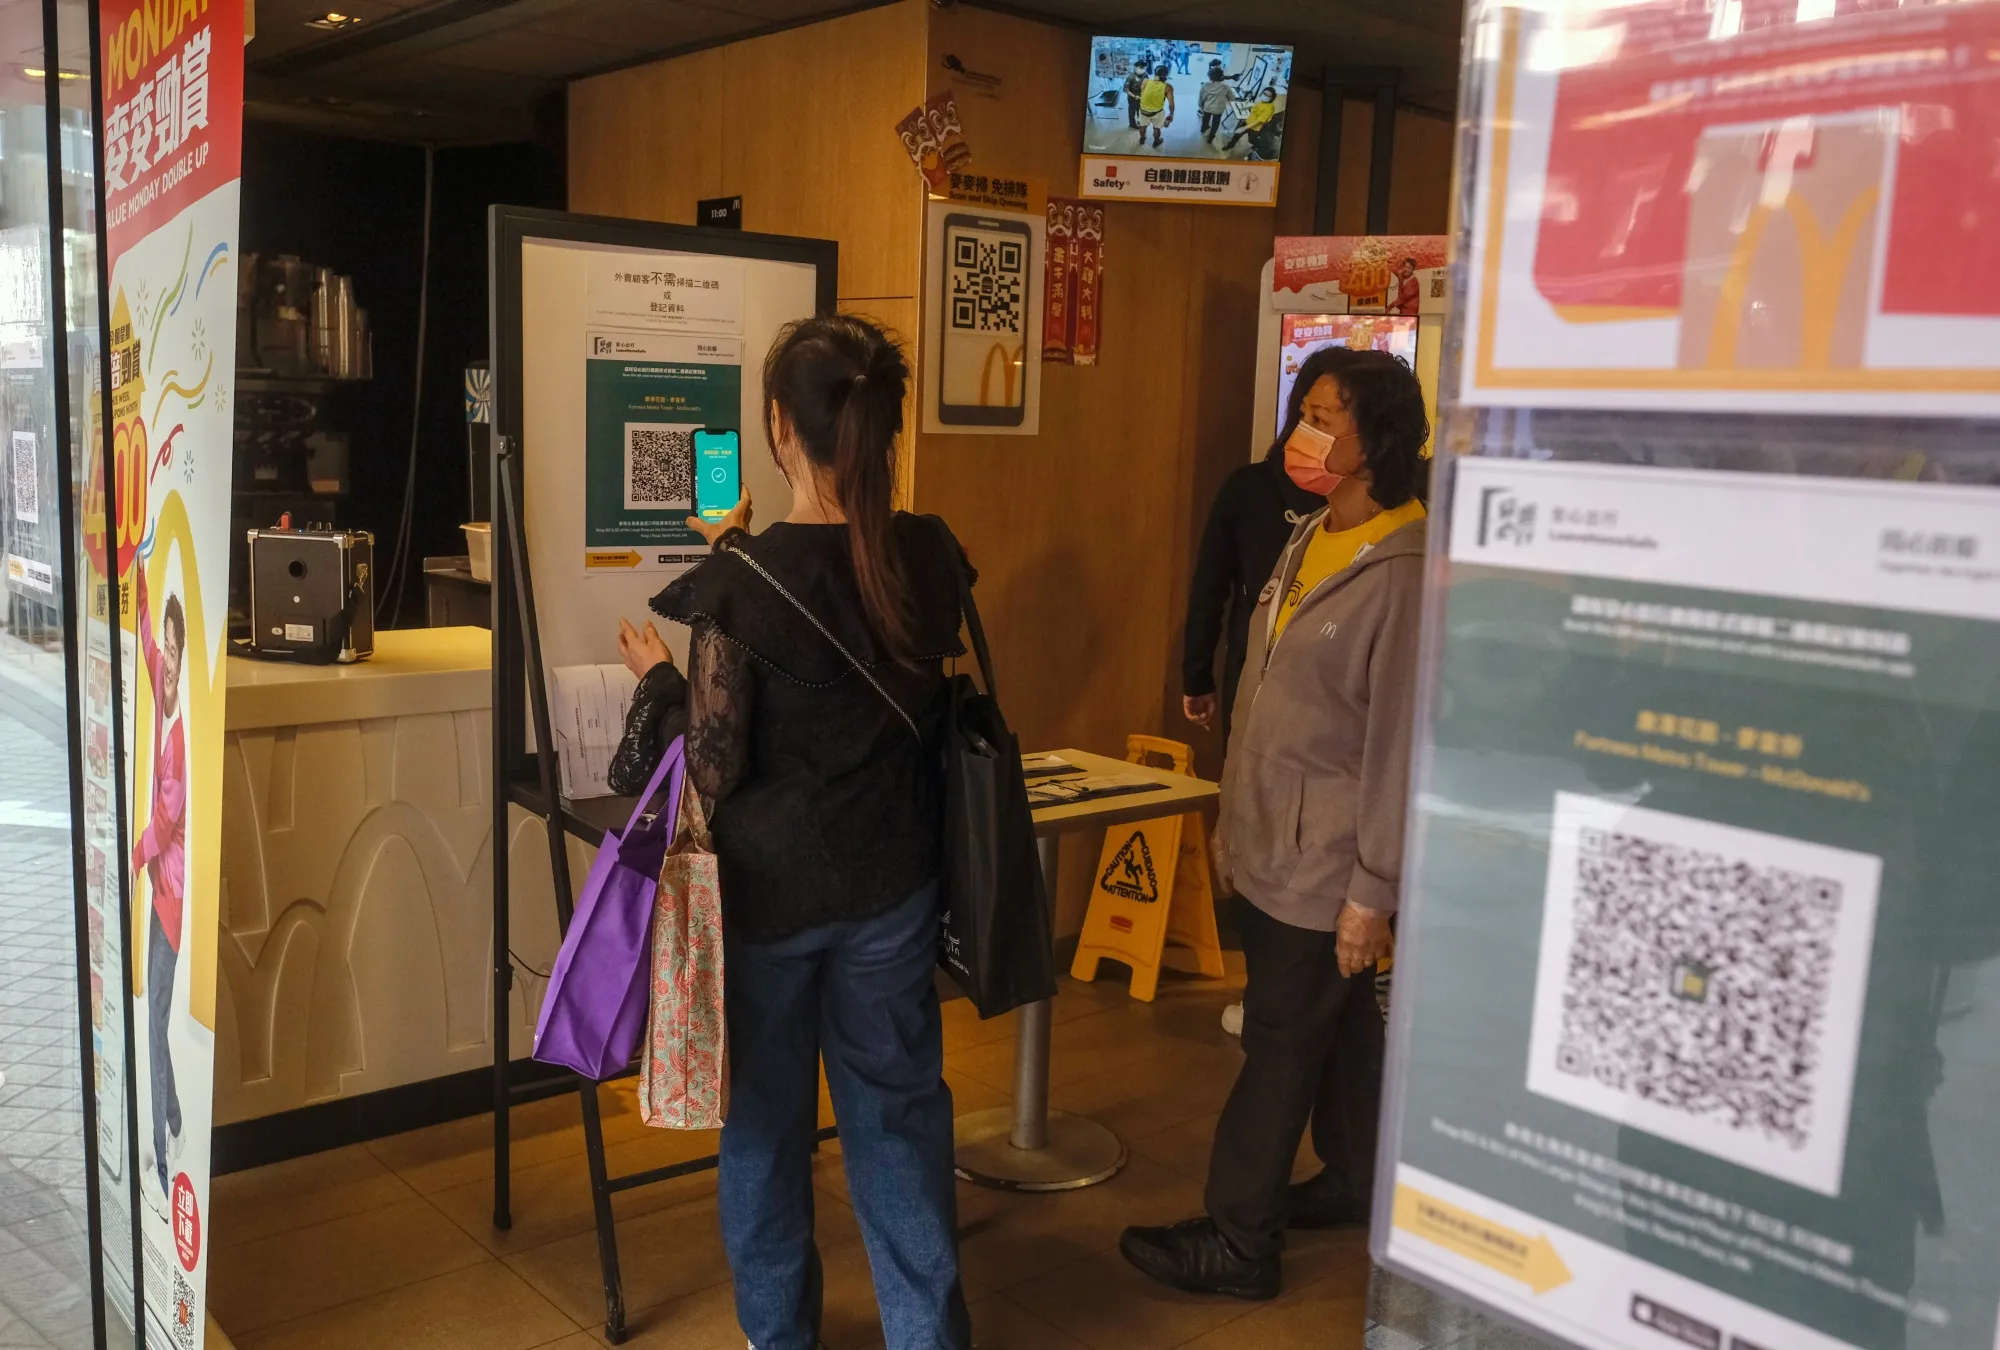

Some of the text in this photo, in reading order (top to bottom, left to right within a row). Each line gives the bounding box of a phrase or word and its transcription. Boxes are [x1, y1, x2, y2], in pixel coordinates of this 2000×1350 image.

[108, 0, 208, 99] MONDA
[128, 176, 160, 219] MONDAY
[162, 151, 193, 195] DOUBLE
[195, 141, 209, 169] UP
[1150, 184, 1166, 192] Body
[1167, 184, 1203, 193] Temperature
[650, 302, 684, 314] 登記資料
[663, 290, 672, 301] 或
[1106, 841, 1133, 876] CAUTION
[1141, 846, 1157, 888] CUIDADO
[1107, 884, 1150, 904] ATTENTION
